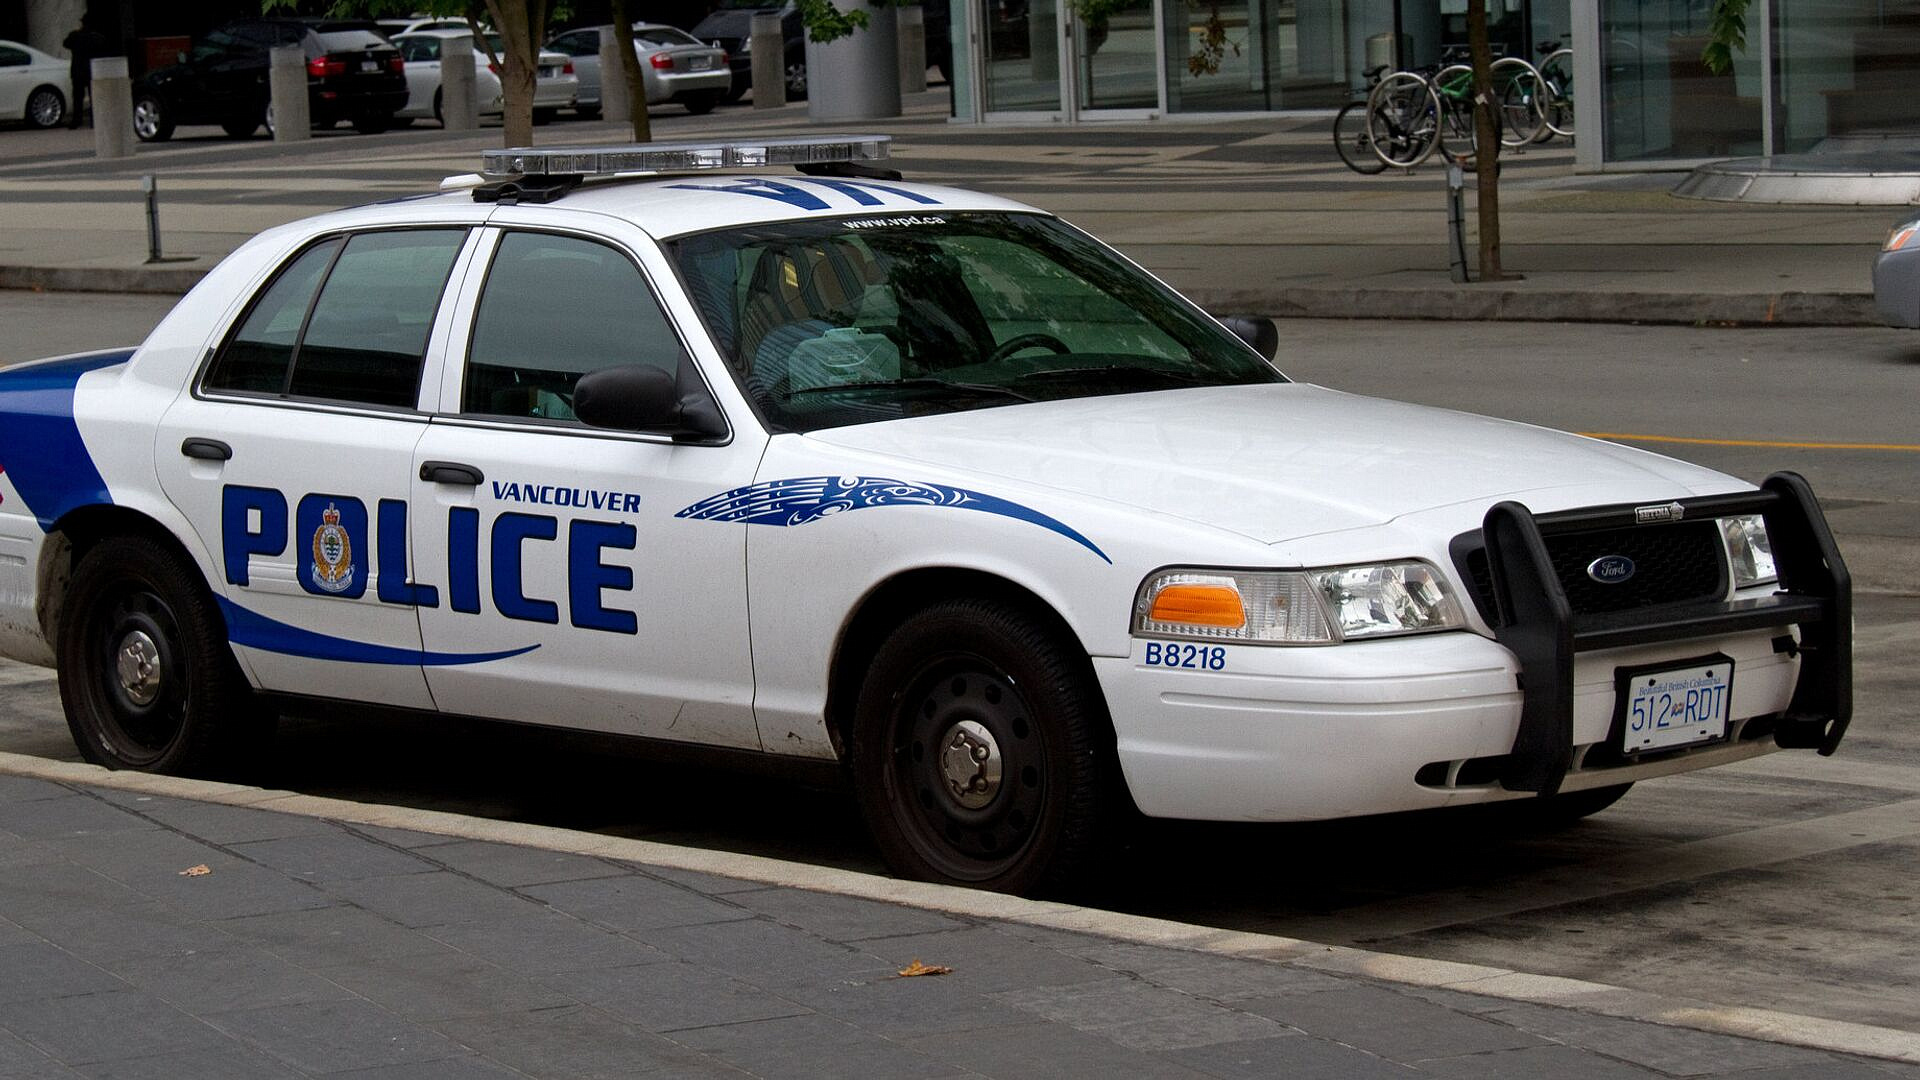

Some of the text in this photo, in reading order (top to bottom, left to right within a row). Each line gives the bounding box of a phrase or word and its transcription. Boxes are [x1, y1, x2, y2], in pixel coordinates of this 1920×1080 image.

[842, 215, 946, 229] www.vpd.ca
[492, 481, 641, 513] VANCOUVER
[222, 483, 638, 635] POLICE
[1601, 561, 1626, 577] Ford
[1146, 642, 1226, 670] B8218
[1632, 685, 1726, 731] 512 RDT
